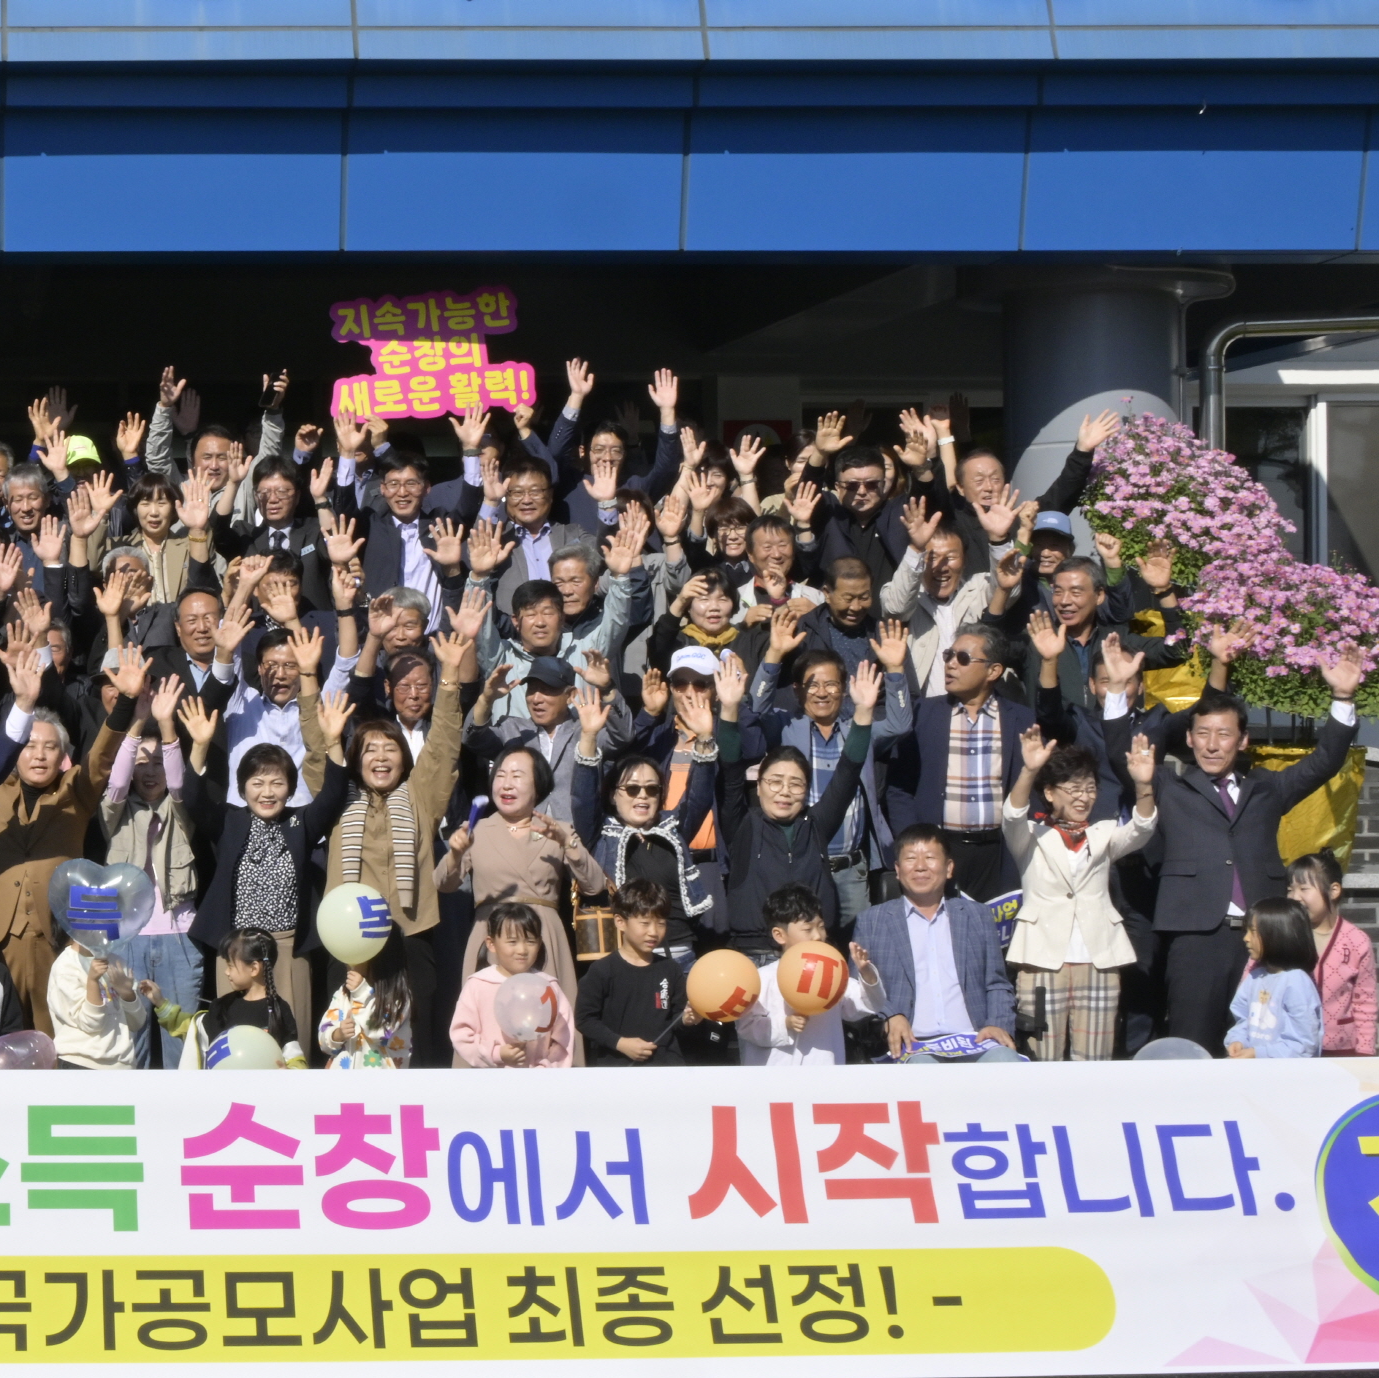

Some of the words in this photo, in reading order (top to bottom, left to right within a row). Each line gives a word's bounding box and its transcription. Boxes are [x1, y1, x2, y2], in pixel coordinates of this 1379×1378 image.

[337, 291, 511, 339] 지속가능한
[377, 333, 482, 376] 순창의
[339, 375, 442, 416] 새로운
[448, 367, 530, 410] 활력!
[67, 886, 123, 941] 득
[180, 1102, 649, 1231] 순창에서
[688, 1100, 1296, 1224] 시작합니다.
[506, 1266, 675, 1347] 최종
[701, 1263, 904, 1345] 선정!
